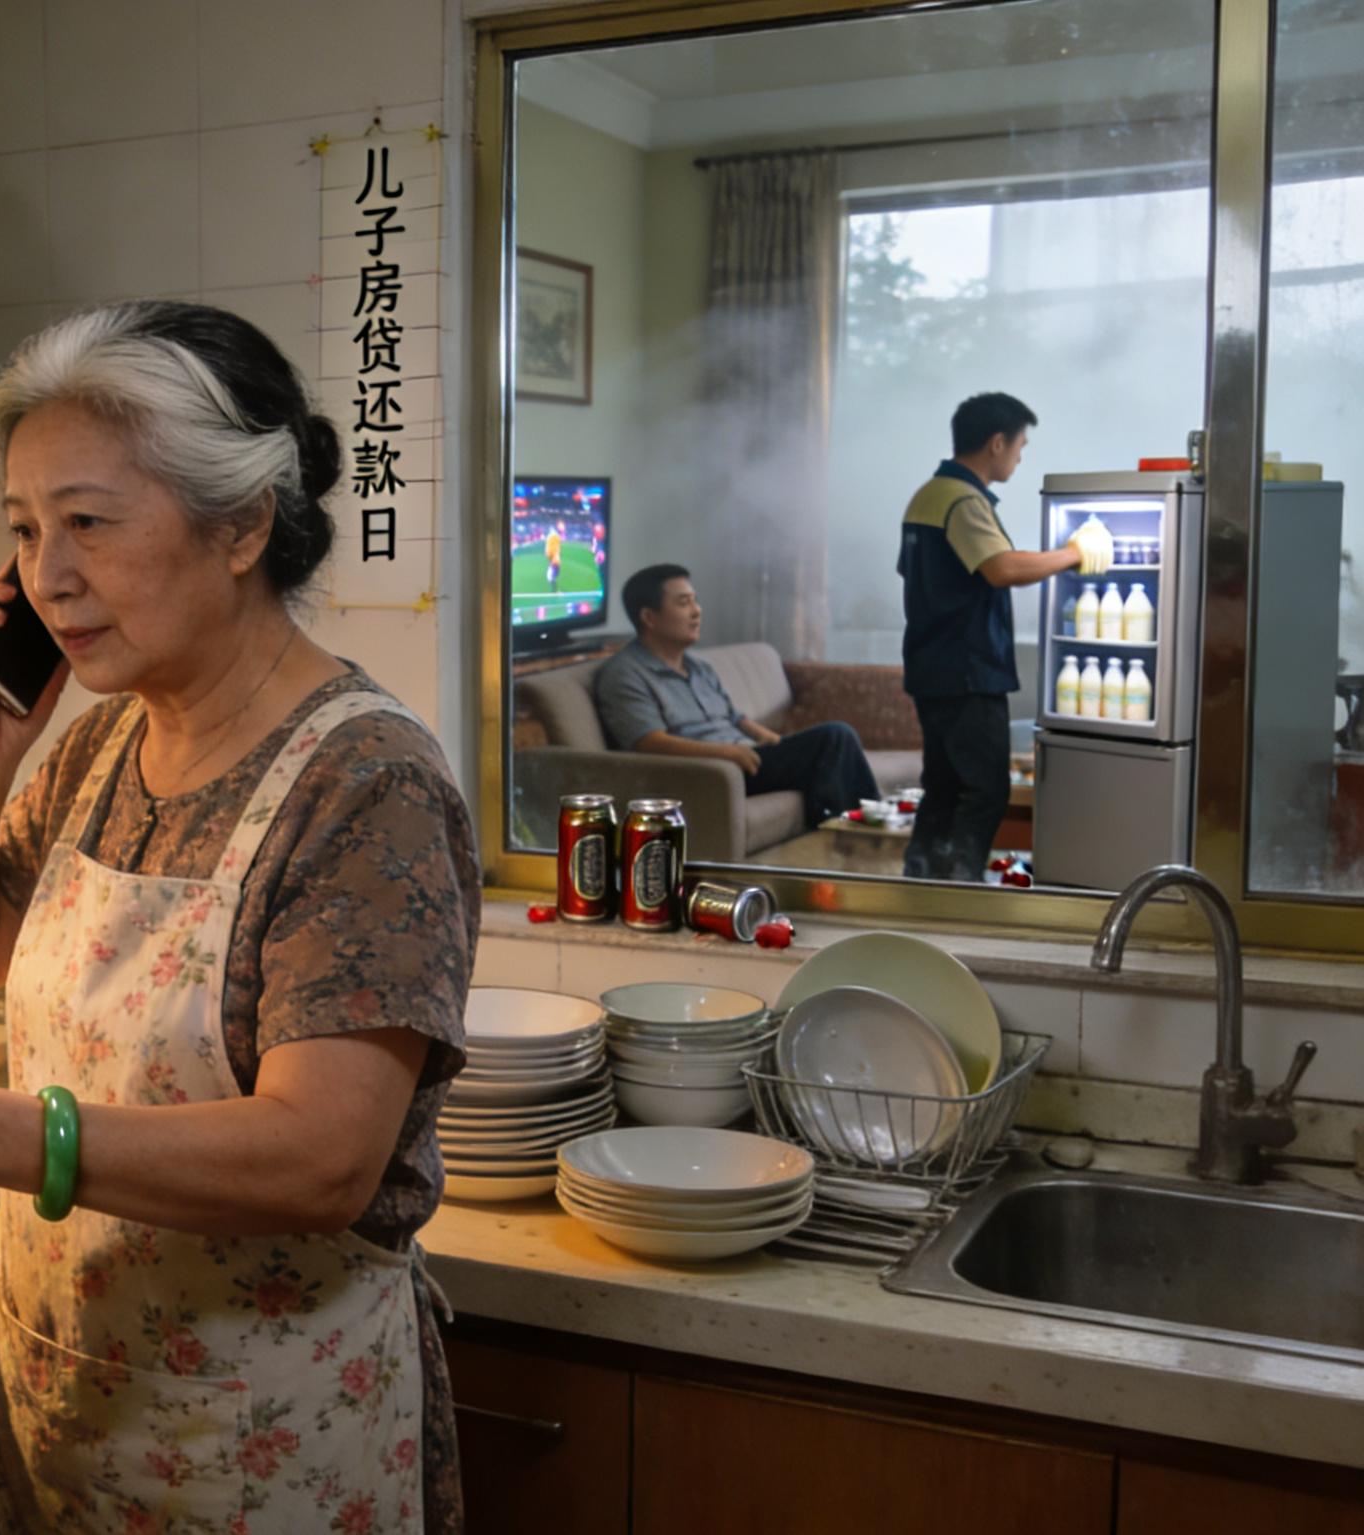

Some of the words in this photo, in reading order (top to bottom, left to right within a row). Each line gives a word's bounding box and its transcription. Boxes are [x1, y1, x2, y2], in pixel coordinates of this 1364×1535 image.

[351, 147, 406, 562] 儿子房贷还款日
